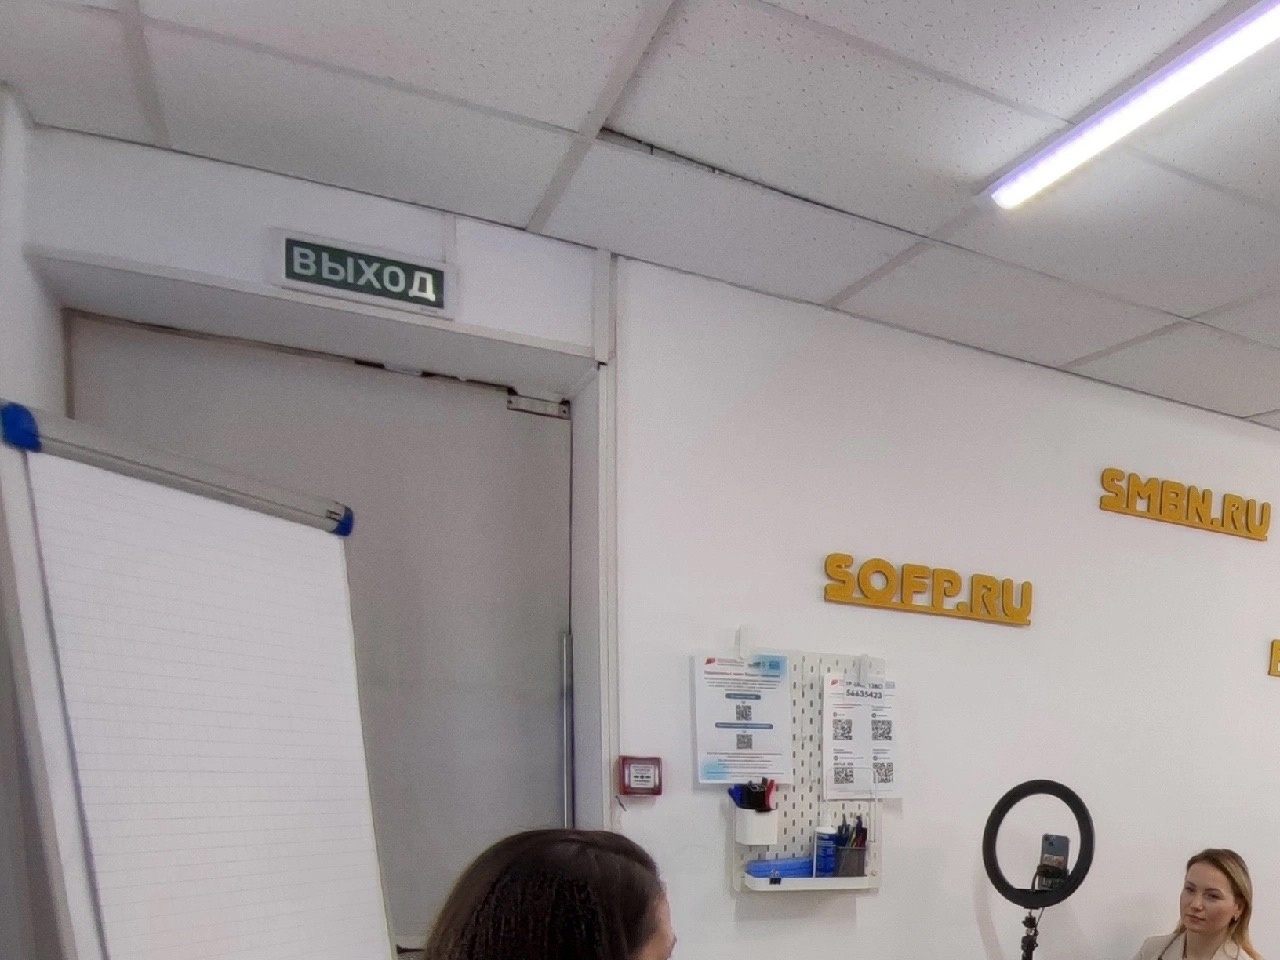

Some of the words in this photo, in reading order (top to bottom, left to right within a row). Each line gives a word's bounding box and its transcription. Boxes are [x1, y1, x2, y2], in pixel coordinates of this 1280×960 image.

[293, 246, 435, 301] ВЫХОД
[1100, 468, 1271, 541] SMBN.RU
[825, 553, 1032, 626] SOFP.RU
